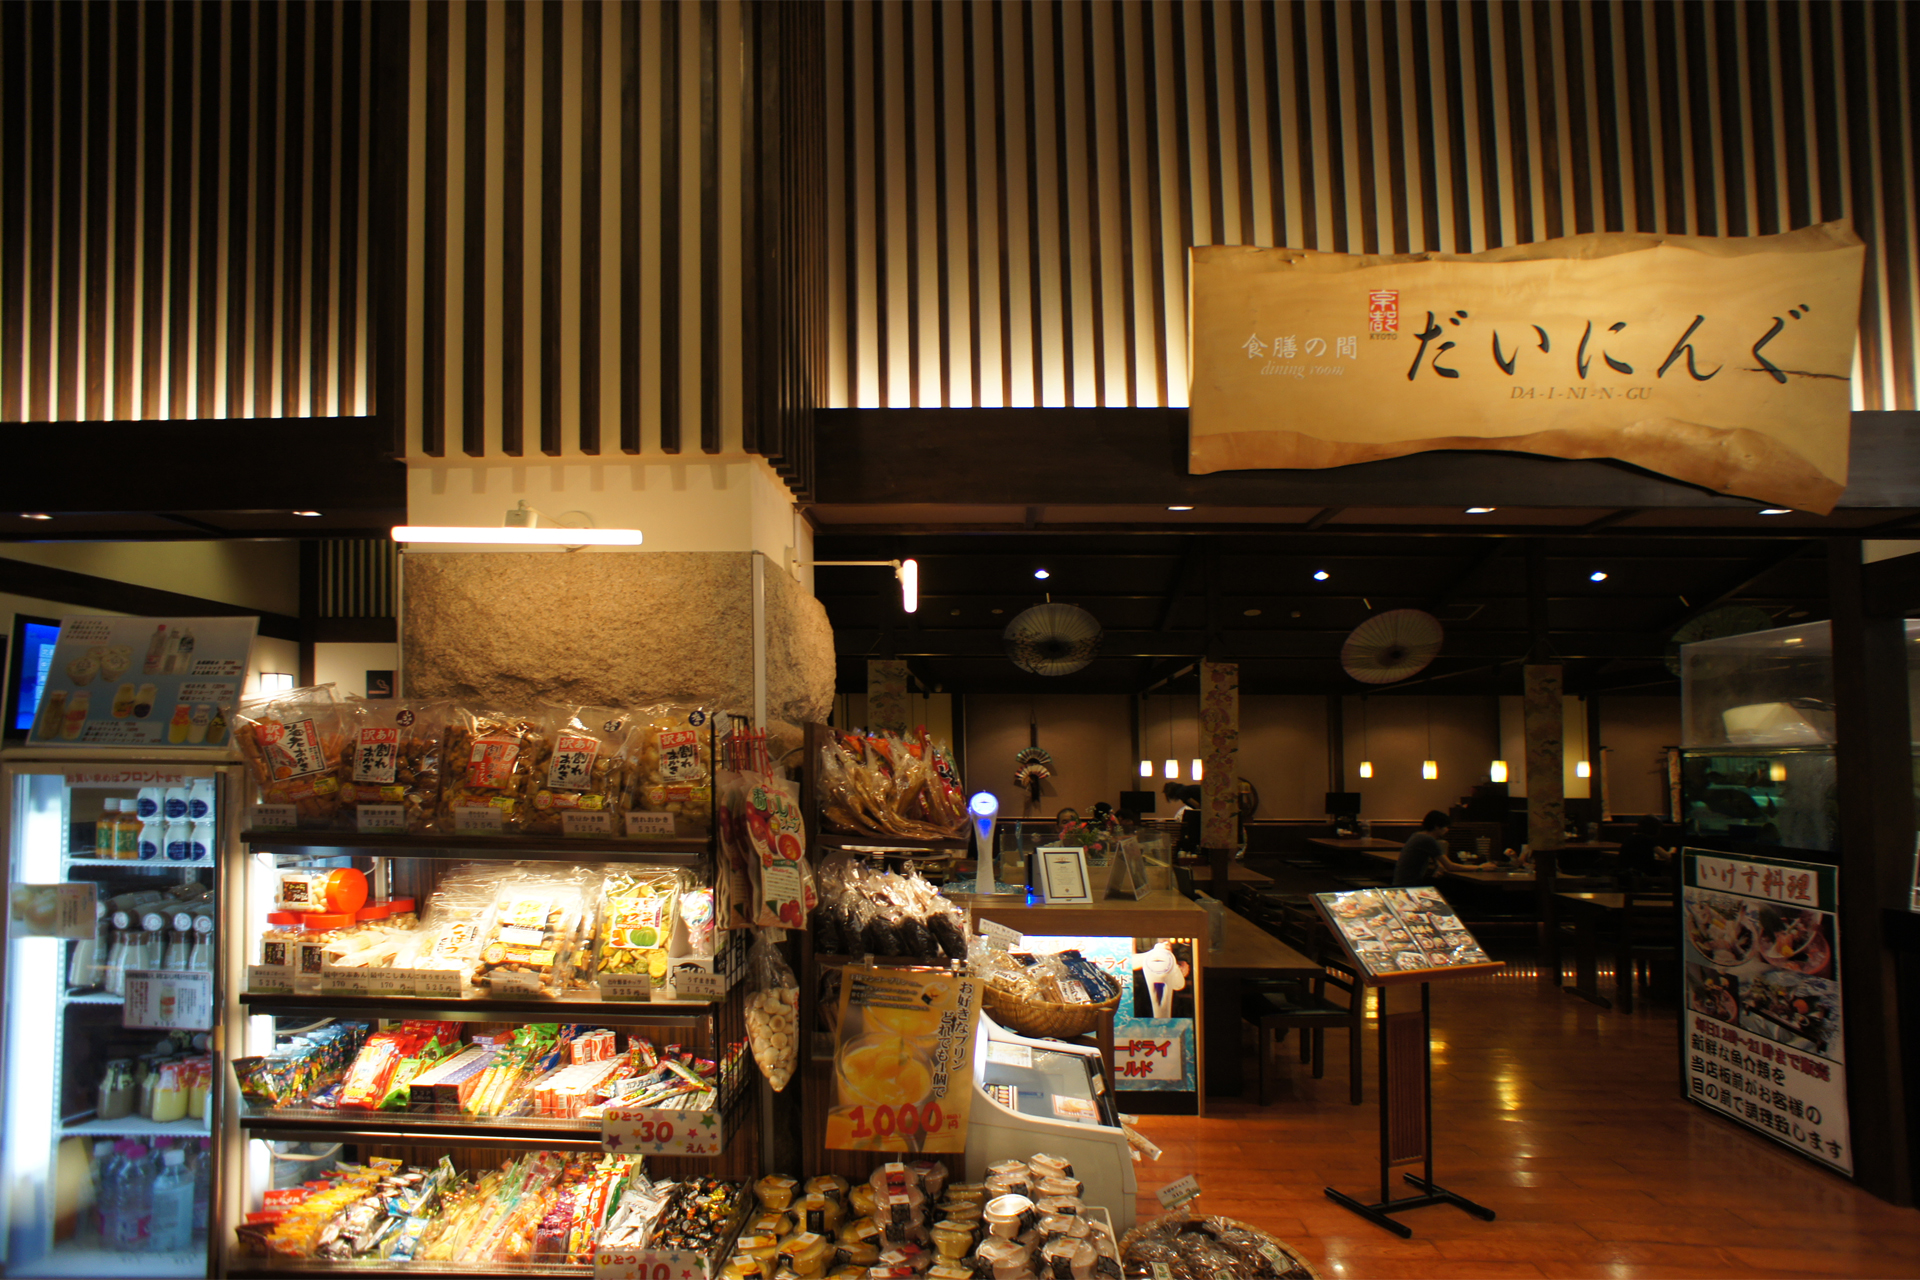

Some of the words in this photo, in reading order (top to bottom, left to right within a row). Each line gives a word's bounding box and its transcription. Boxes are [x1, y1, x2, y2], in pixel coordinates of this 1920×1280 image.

[1241, 333, 1358, 360] 食膳の間
[1407, 303, 1810, 384] だいにんぐ
[1260, 360, 1306, 379] dining
[1309, 366, 1345, 376] room
[363, 730, 395, 741] 訳あり
[559, 738, 594, 750] 訳あり
[662, 732, 694, 745] 訳あり
[362, 746, 374, 774] おかき
[374, 743, 391, 769] 割れ
[557, 753, 570, 780] おかき
[571, 752, 589, 776] 割れ
[666, 749, 679, 775] おかき
[678, 744, 693, 768] 割れ
[1700, 862, 1812, 901] いけす料理
[323, 971, 368, 979] 最中つぶあん
[370, 971, 414, 980] 最中こしあん
[1691, 1033, 1786, 1087] 新鮮な魚介類を
[1690, 1055, 1822, 1125] 当店板前がお客様の
[609, 1111, 644, 1122] ひとつ
[848, 1101, 943, 1138] 1000
[948, 1119, 959, 1130] 円
[1691, 1076, 1843, 1159] 目の前で調理致します
[641, 1121, 674, 1143] 30
[685, 1143, 706, 1153] えん
[601, 1254, 637, 1265] ひとつ
[638, 1263, 671, 1280] 10
